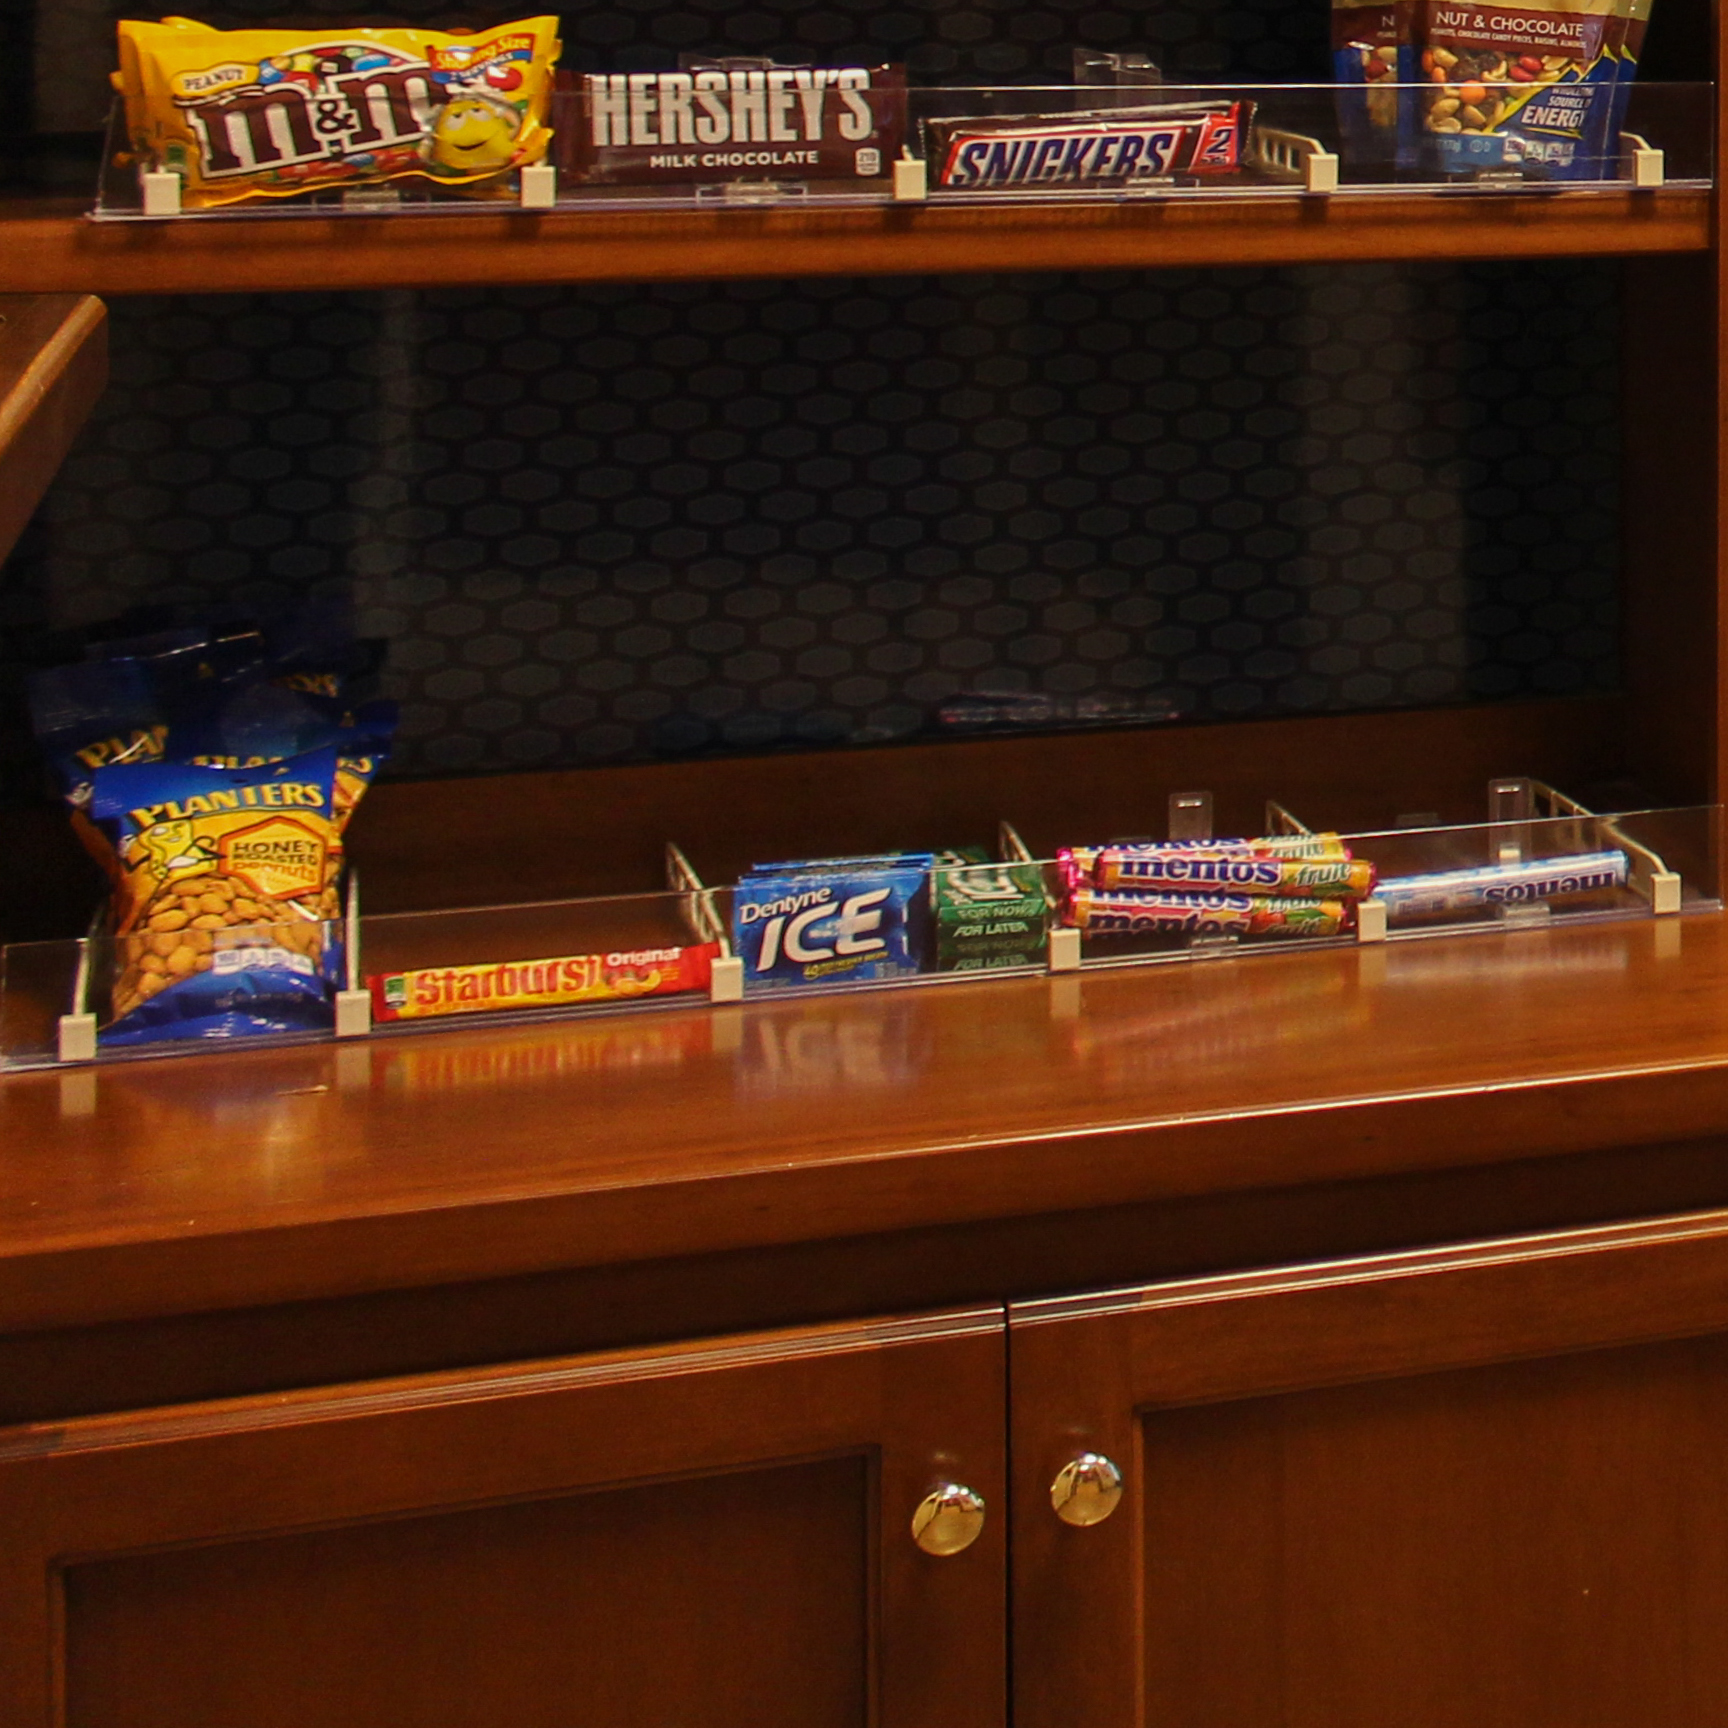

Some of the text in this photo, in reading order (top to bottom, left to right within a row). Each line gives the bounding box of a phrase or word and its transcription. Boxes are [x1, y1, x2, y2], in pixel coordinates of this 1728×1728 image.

[1436, 11, 1584, 38] NUT & CHOCOLATE
[497, 35, 532, 53] Size
[183, 67, 246, 92] PEANUT
[590, 68, 872, 147] HERSHEY'S
[1205, 128, 1235, 157] 2
[650, 150, 819, 169] MILK CHOCOLATE
[956, 132, 1173, 186] SNICKERS
[131, 782, 327, 827] PLANTERS
[232, 852, 319, 867] ROASTED
[233, 840, 320, 855] HONEY
[1119, 854, 1353, 887] mentos fruit
[739, 886, 833, 924] Dentyne
[756, 887, 892, 973] ICE
[952, 924, 983, 938] FOR
[605, 947, 682, 967] Original
[413, 953, 602, 1006] Starburst
